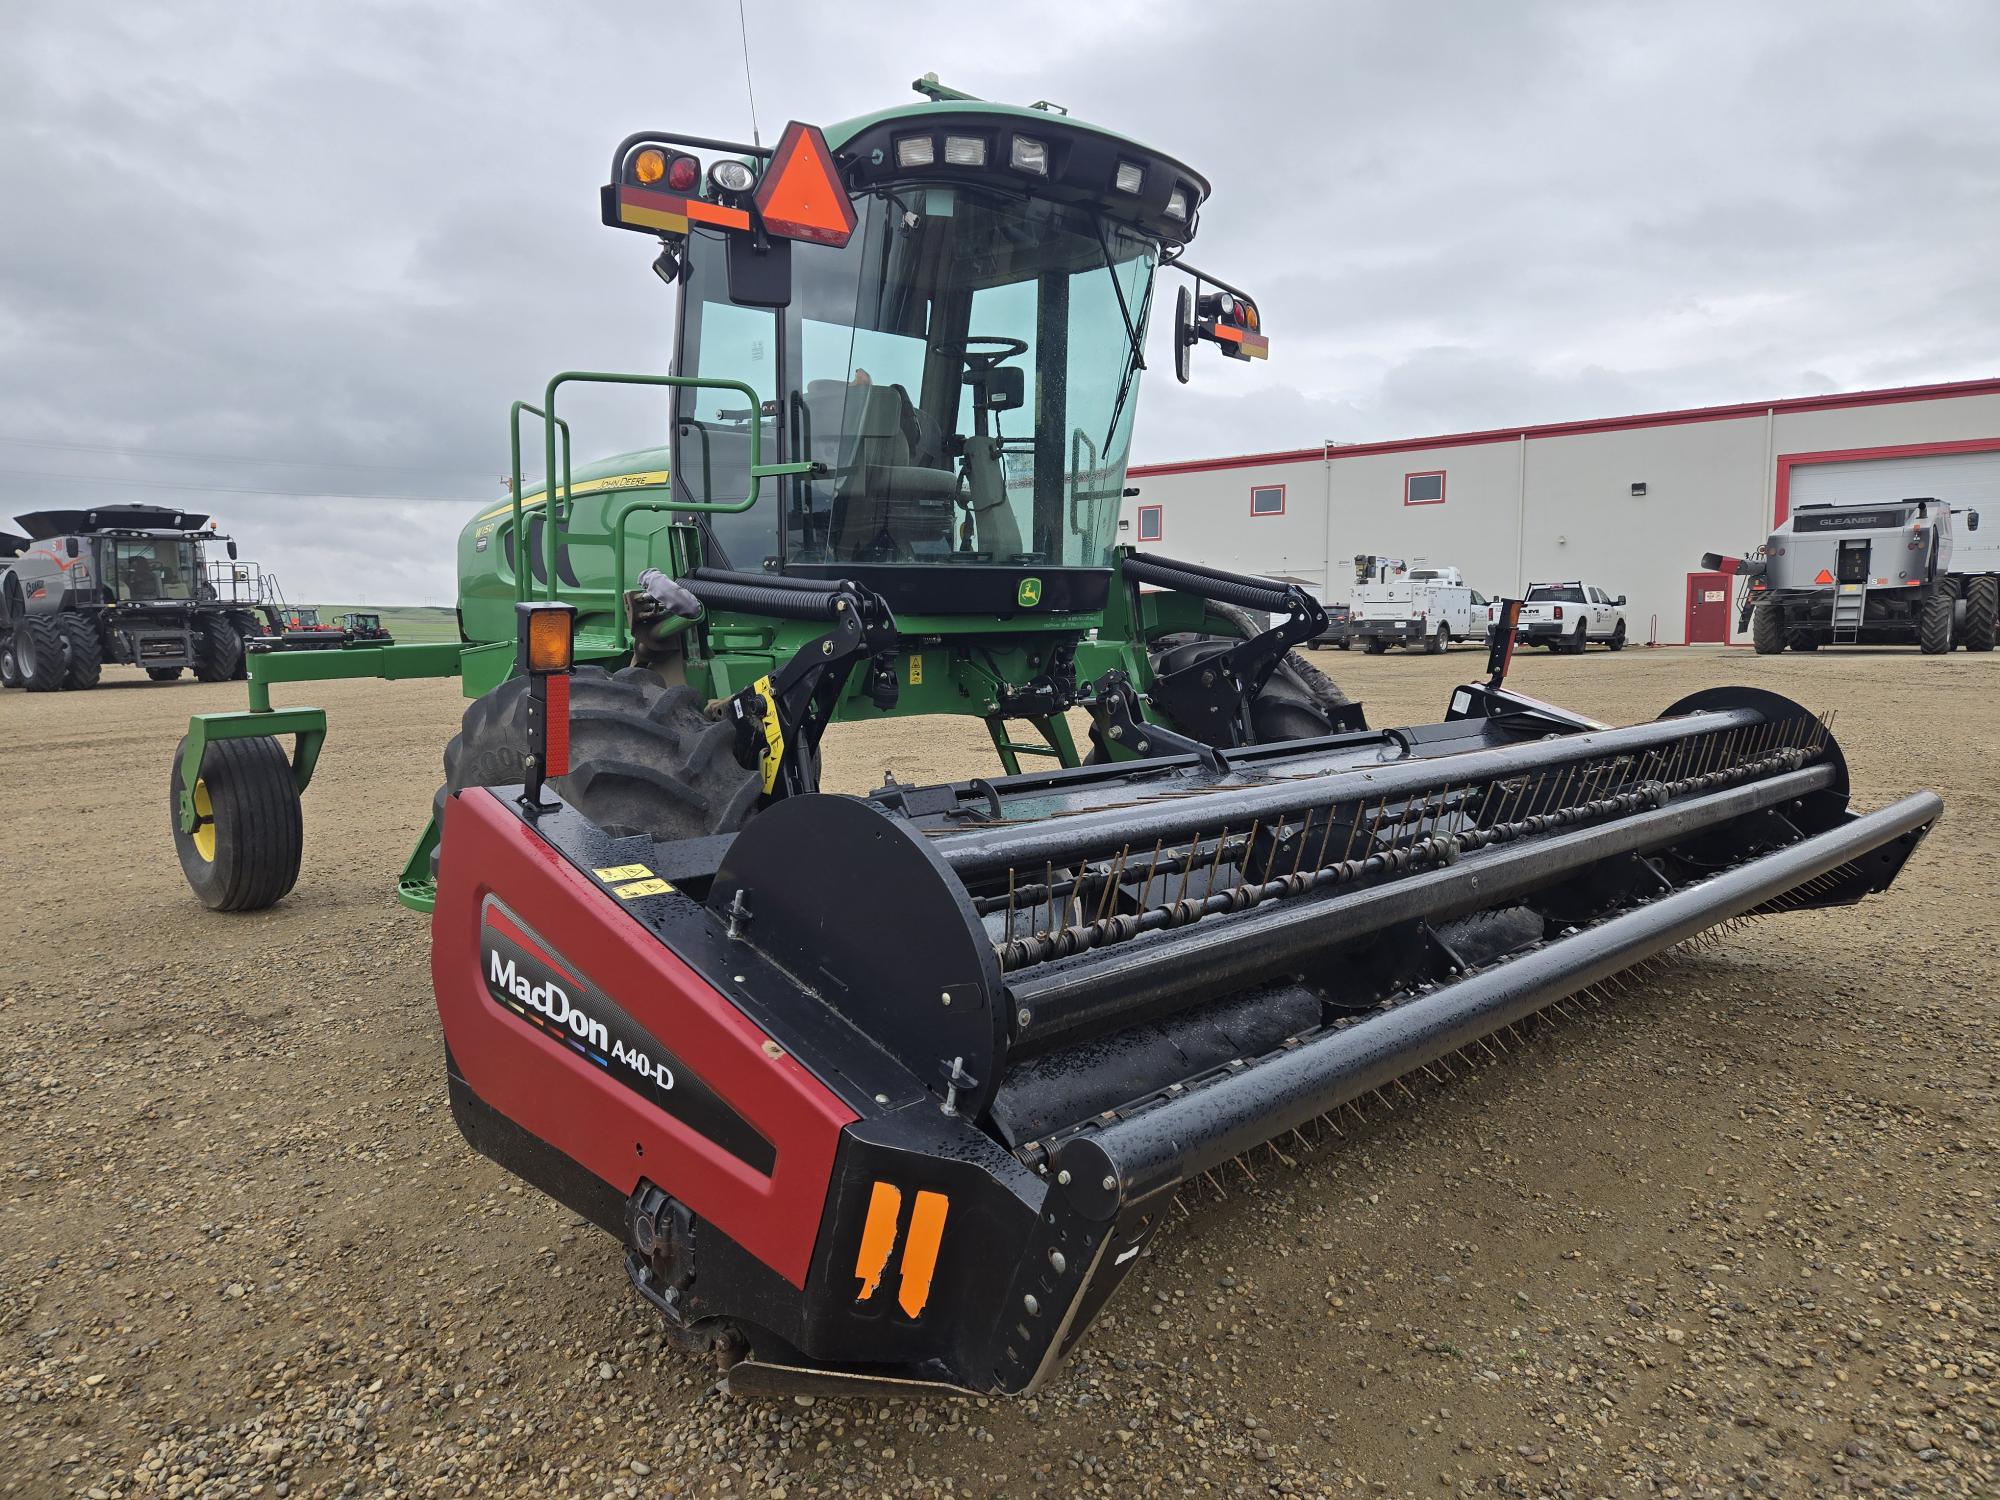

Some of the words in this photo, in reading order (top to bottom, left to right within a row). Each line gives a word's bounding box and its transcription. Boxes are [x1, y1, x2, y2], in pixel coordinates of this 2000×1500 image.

[600, 479, 620, 489] JOHN
[620, 476, 647, 487] DEERE
[1819, 516, 1878, 526] GLEANER
[475, 523, 496, 538] W150
[490, 949, 608, 1052] MacDon
[611, 1039, 675, 1091] A40-D
